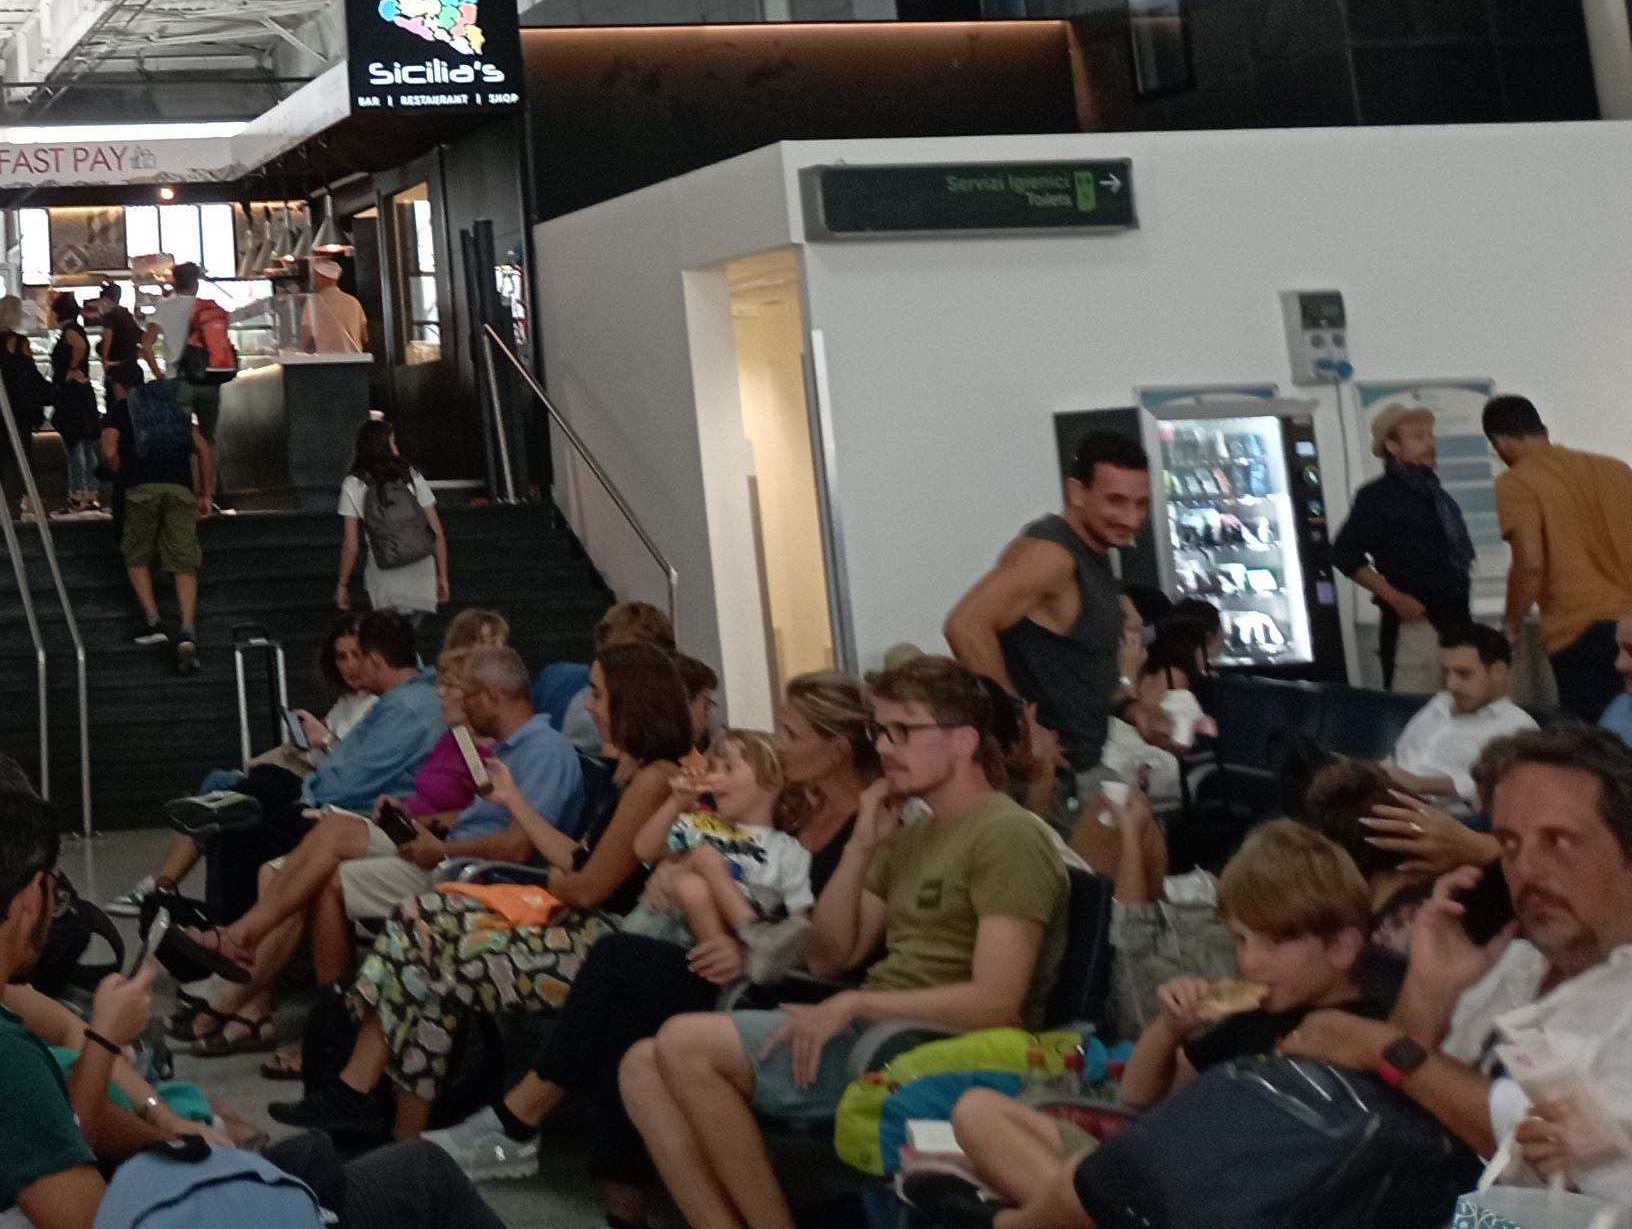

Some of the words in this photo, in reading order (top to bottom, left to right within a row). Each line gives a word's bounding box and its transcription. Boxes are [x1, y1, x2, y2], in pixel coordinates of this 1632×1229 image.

[368, 58, 506, 85] Sicilia's
[357, 96, 381, 107] BAR
[400, 94, 469, 106] RESTAURANT
[488, 93, 520, 104] SHOP
[72, 146, 129, 172] PAY
[946, 174, 1006, 191] Servizi
[1026, 191, 1073, 207] Toilets
